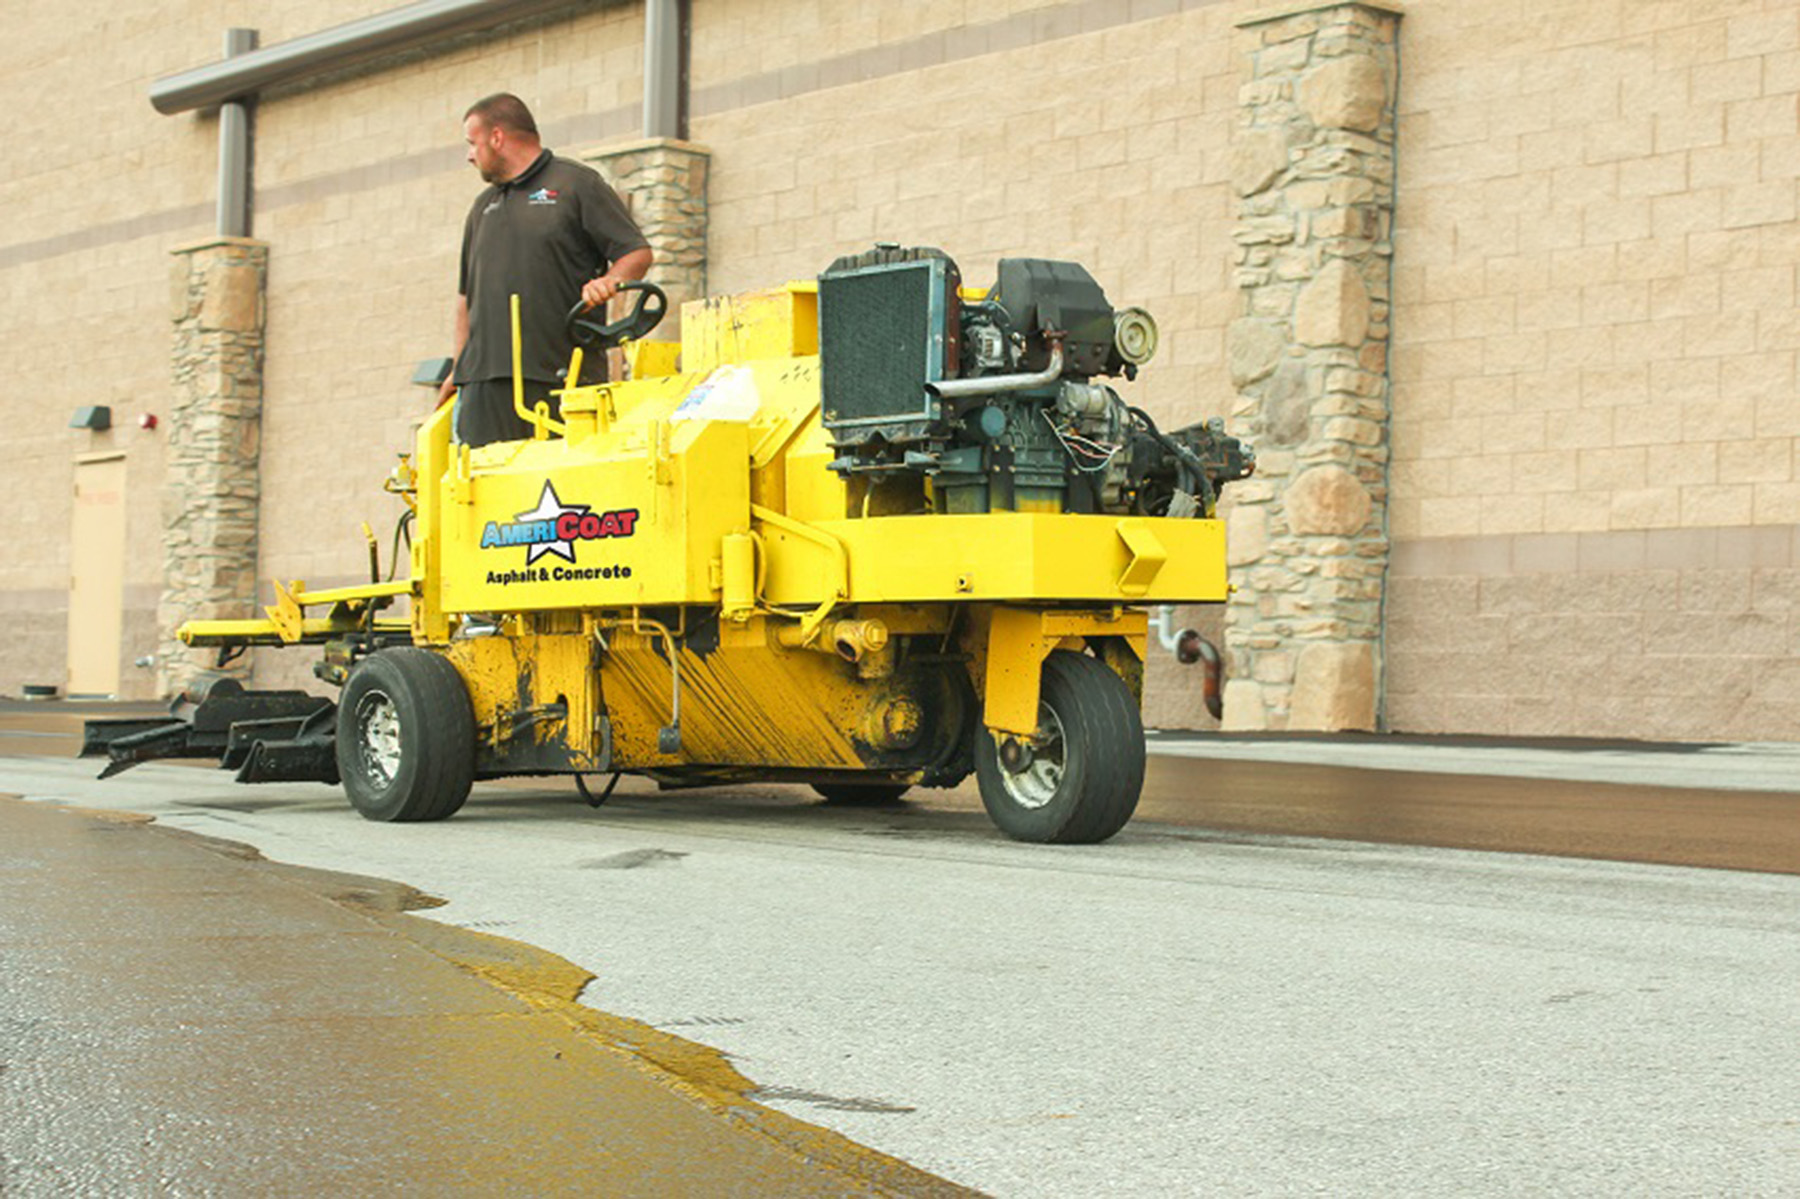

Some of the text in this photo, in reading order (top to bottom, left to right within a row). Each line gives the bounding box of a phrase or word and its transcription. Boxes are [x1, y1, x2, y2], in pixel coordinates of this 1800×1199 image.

[486, 564, 632, 585] Asphalt & Concrete
